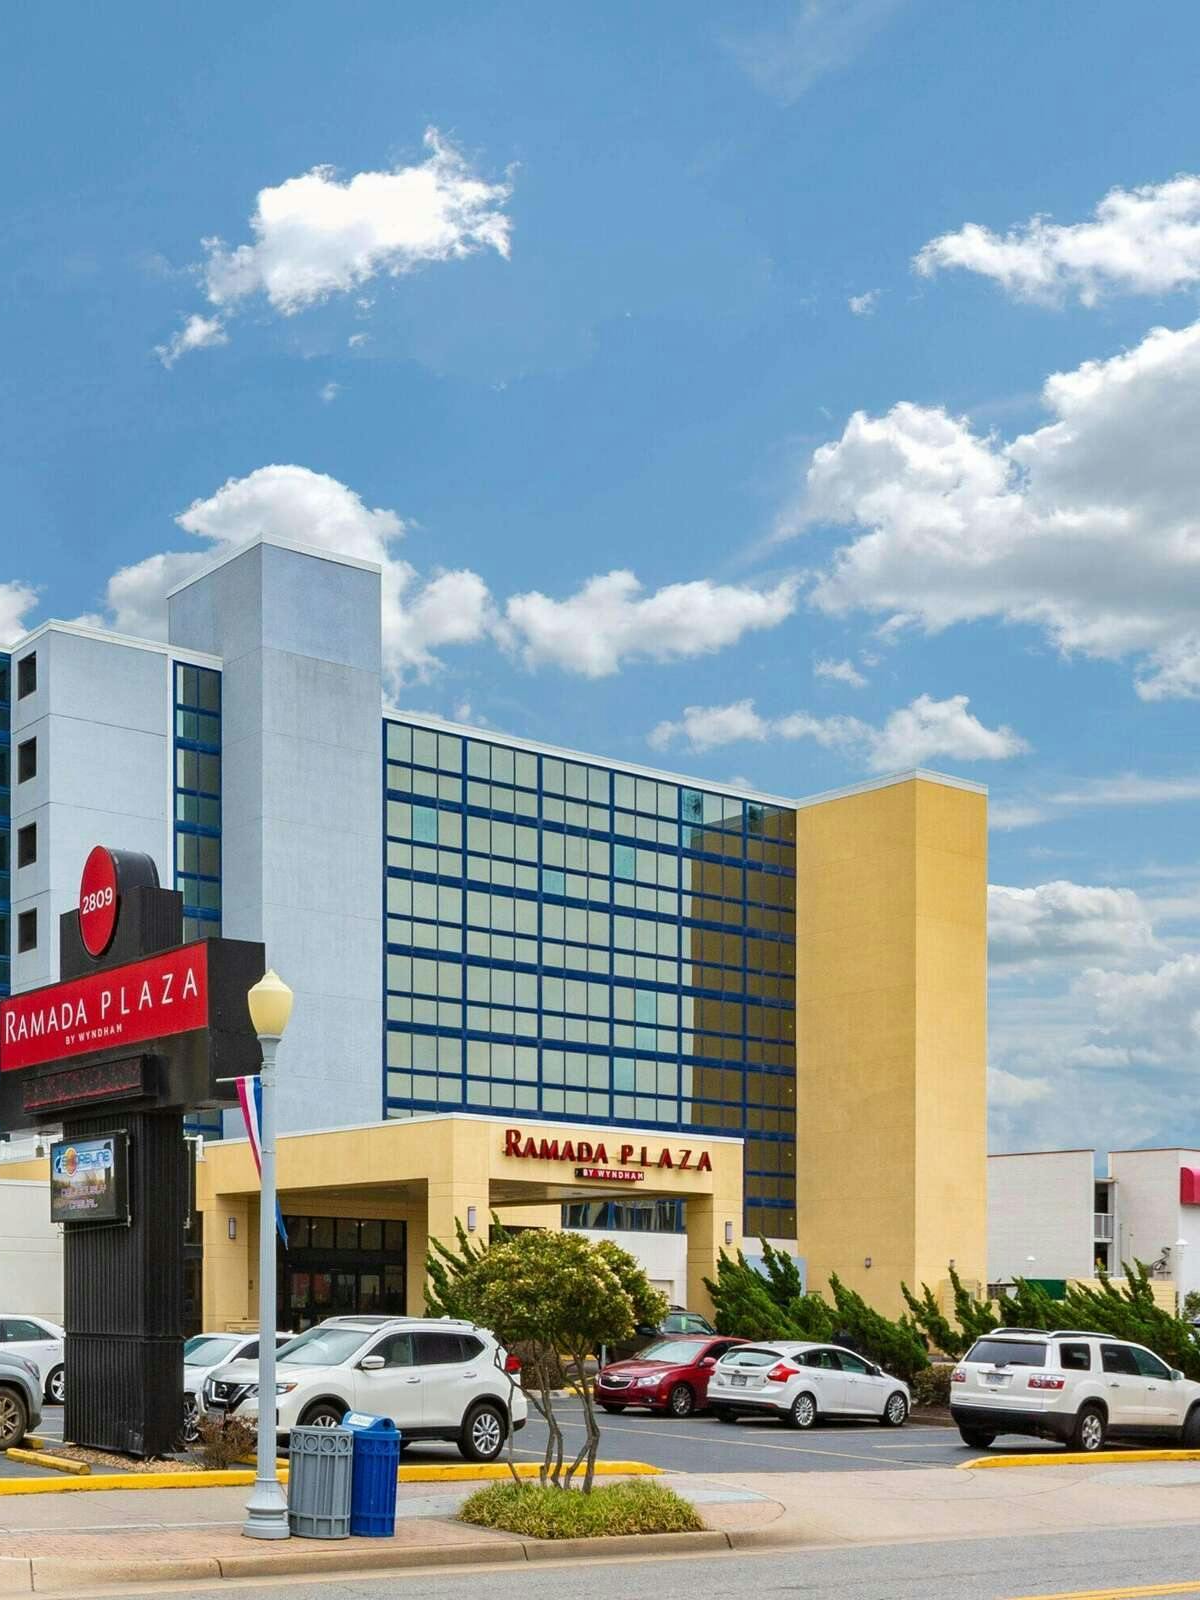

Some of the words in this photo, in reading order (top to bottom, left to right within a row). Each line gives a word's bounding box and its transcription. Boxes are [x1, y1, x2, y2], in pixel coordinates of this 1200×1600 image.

[82, 886, 113, 915] 2809
[5, 998, 88, 1045] RAMADA
[100, 967, 198, 1020] PLAZA
[65, 1034, 75, 1046] BY
[78, 1023, 123, 1042] WYNDHAM
[505, 1129, 608, 1164] RAMADA
[621, 1144, 713, 1172] PLAZA
[583, 1168, 594, 1177] BY
[597, 1169, 644, 1180] WYNDHAM
